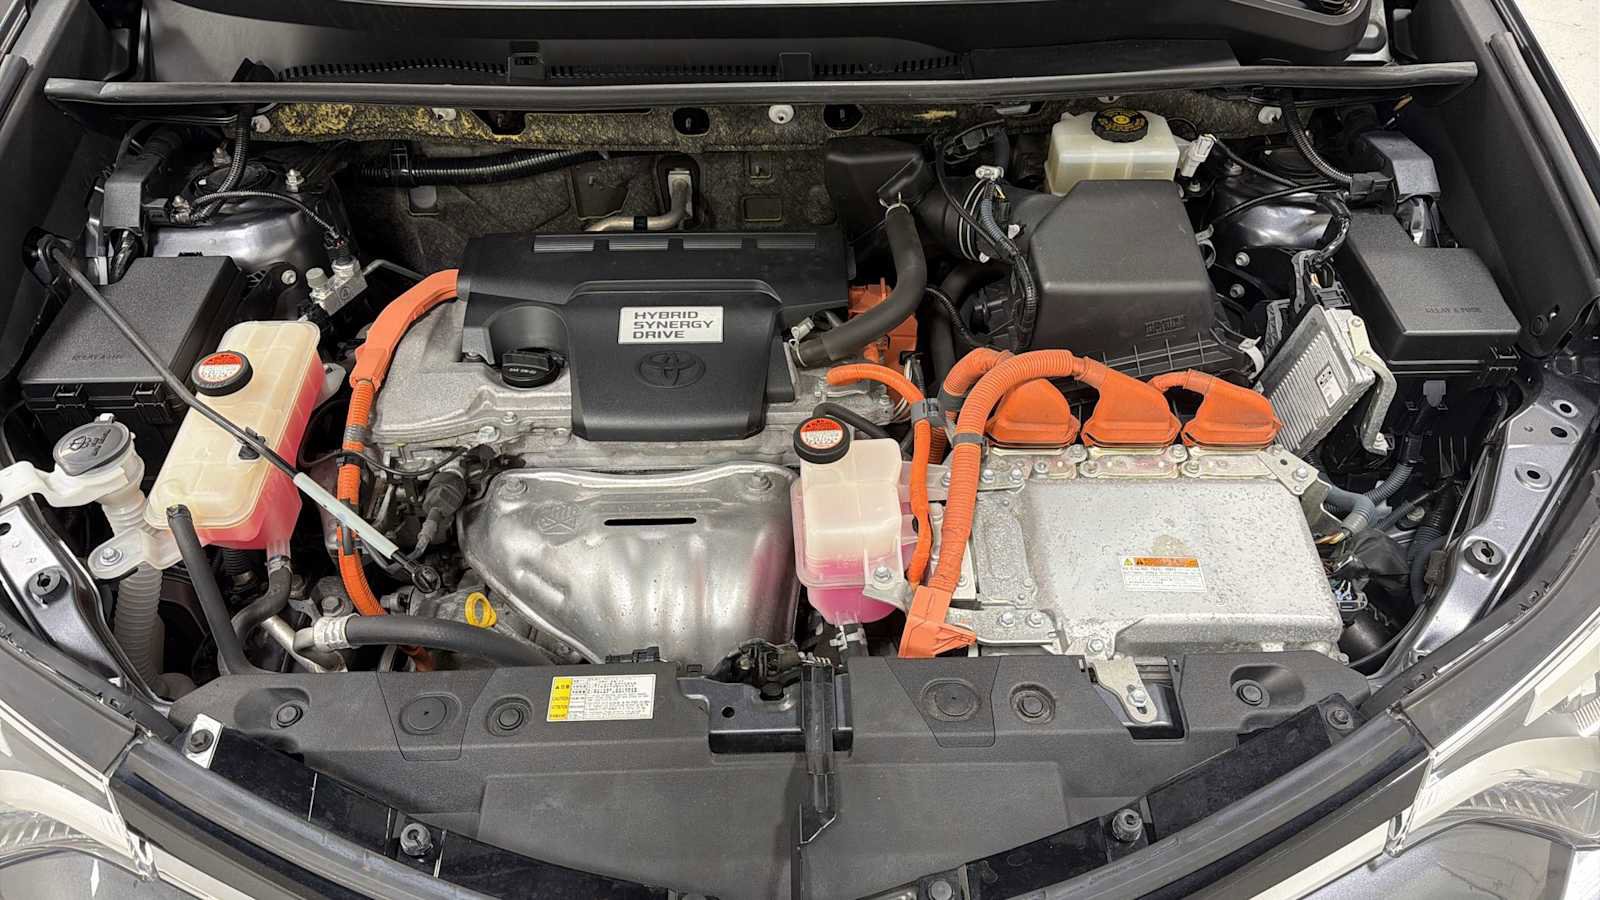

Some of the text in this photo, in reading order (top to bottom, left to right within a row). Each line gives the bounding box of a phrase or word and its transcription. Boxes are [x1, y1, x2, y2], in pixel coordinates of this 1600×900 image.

[634, 311, 698, 319] HYBRID
[633, 320, 714, 330] SYNERGY
[633, 331, 685, 339] DRIVE
